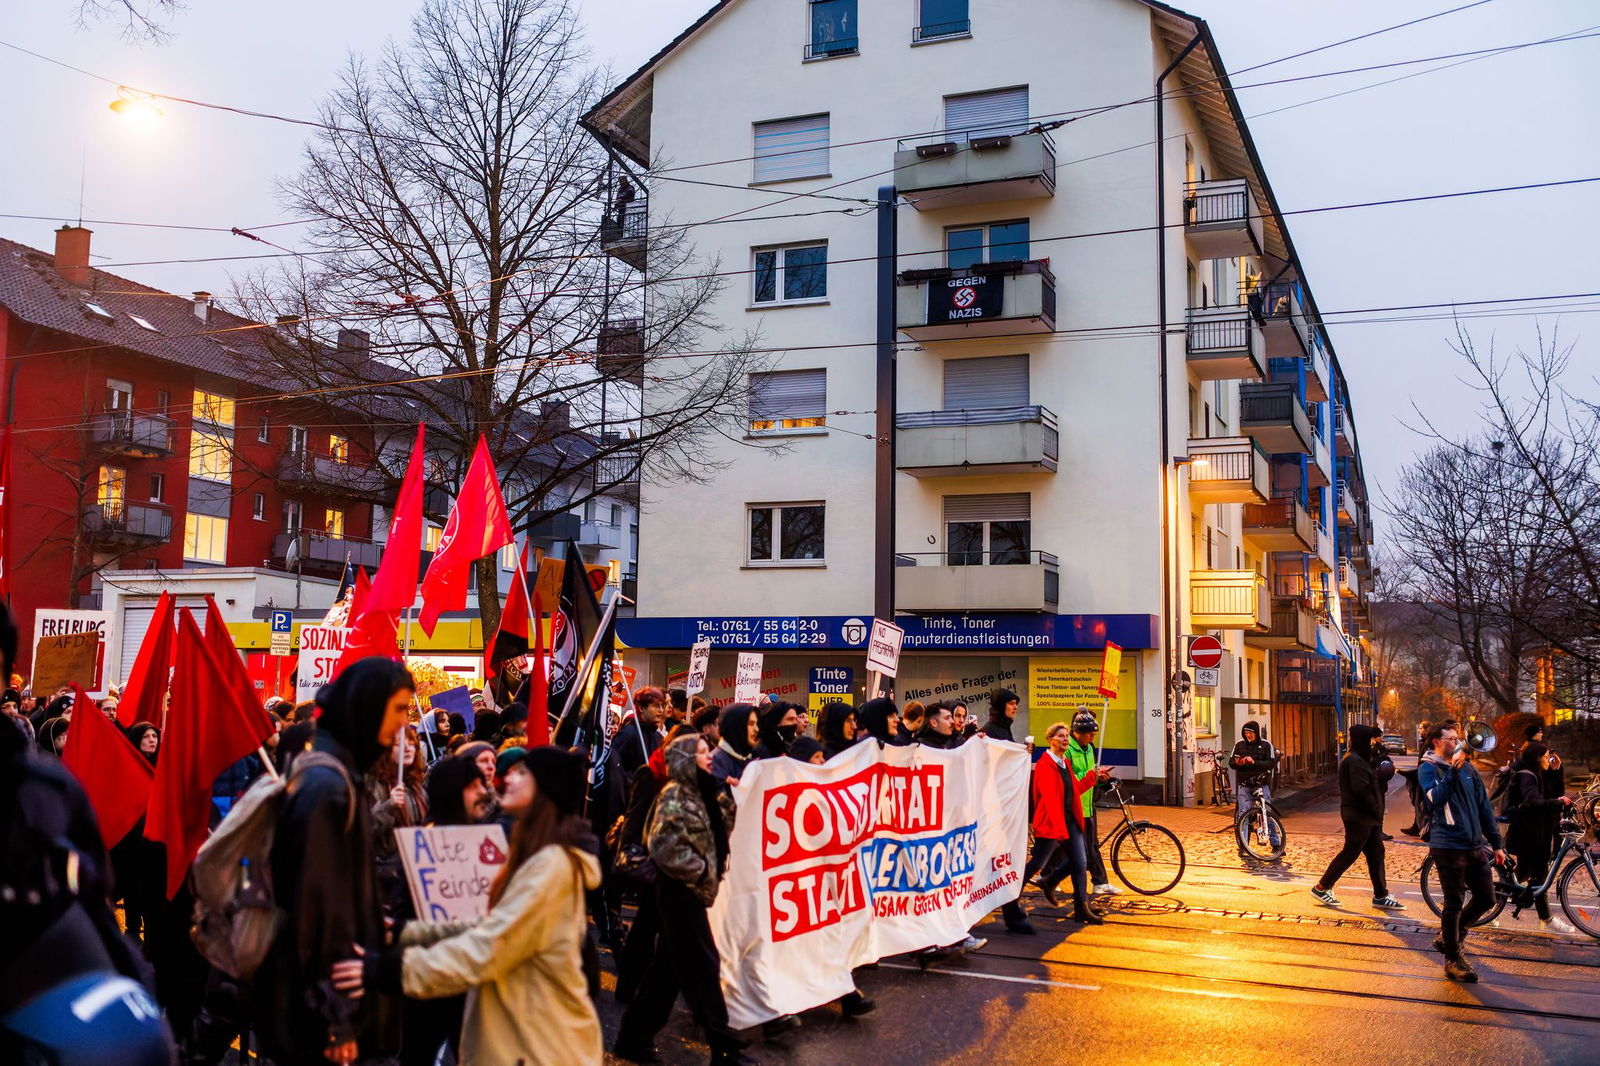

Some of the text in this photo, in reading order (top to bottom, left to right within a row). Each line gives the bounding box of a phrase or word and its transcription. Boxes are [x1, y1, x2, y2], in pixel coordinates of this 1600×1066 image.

[947, 276, 986, 288] GEGEN
[949, 307, 982, 319] NAZIS
[275, 613, 286, 630] P
[697, 620, 719, 631] Tel.:
[722, 620, 750, 631] 0761
[764, 620, 778, 631] 55
[782, 620, 797, 631] 64
[799, 619, 818, 631] 2-0
[922, 617, 996, 630] Tinte, Toner
[42, 618, 106, 639] FREIBURG
[697, 634, 720, 644] Fax:
[722, 633, 751, 645] 0761
[764, 633, 778, 645] 55
[782, 633, 797, 645] 64
[799, 633, 826, 645] 2-29
[903, 632, 1050, 647] mputerdienstleistungen
[815, 667, 847, 680] Tinte
[814, 681, 849, 693] Toner
[904, 669, 1017, 701] Alles eine Frage der
[1151, 709, 1162, 718] 38
[765, 765, 941, 860] SOLIDARITÄT
[414, 829, 469, 864] Alte
[418, 864, 490, 900] Feinde
